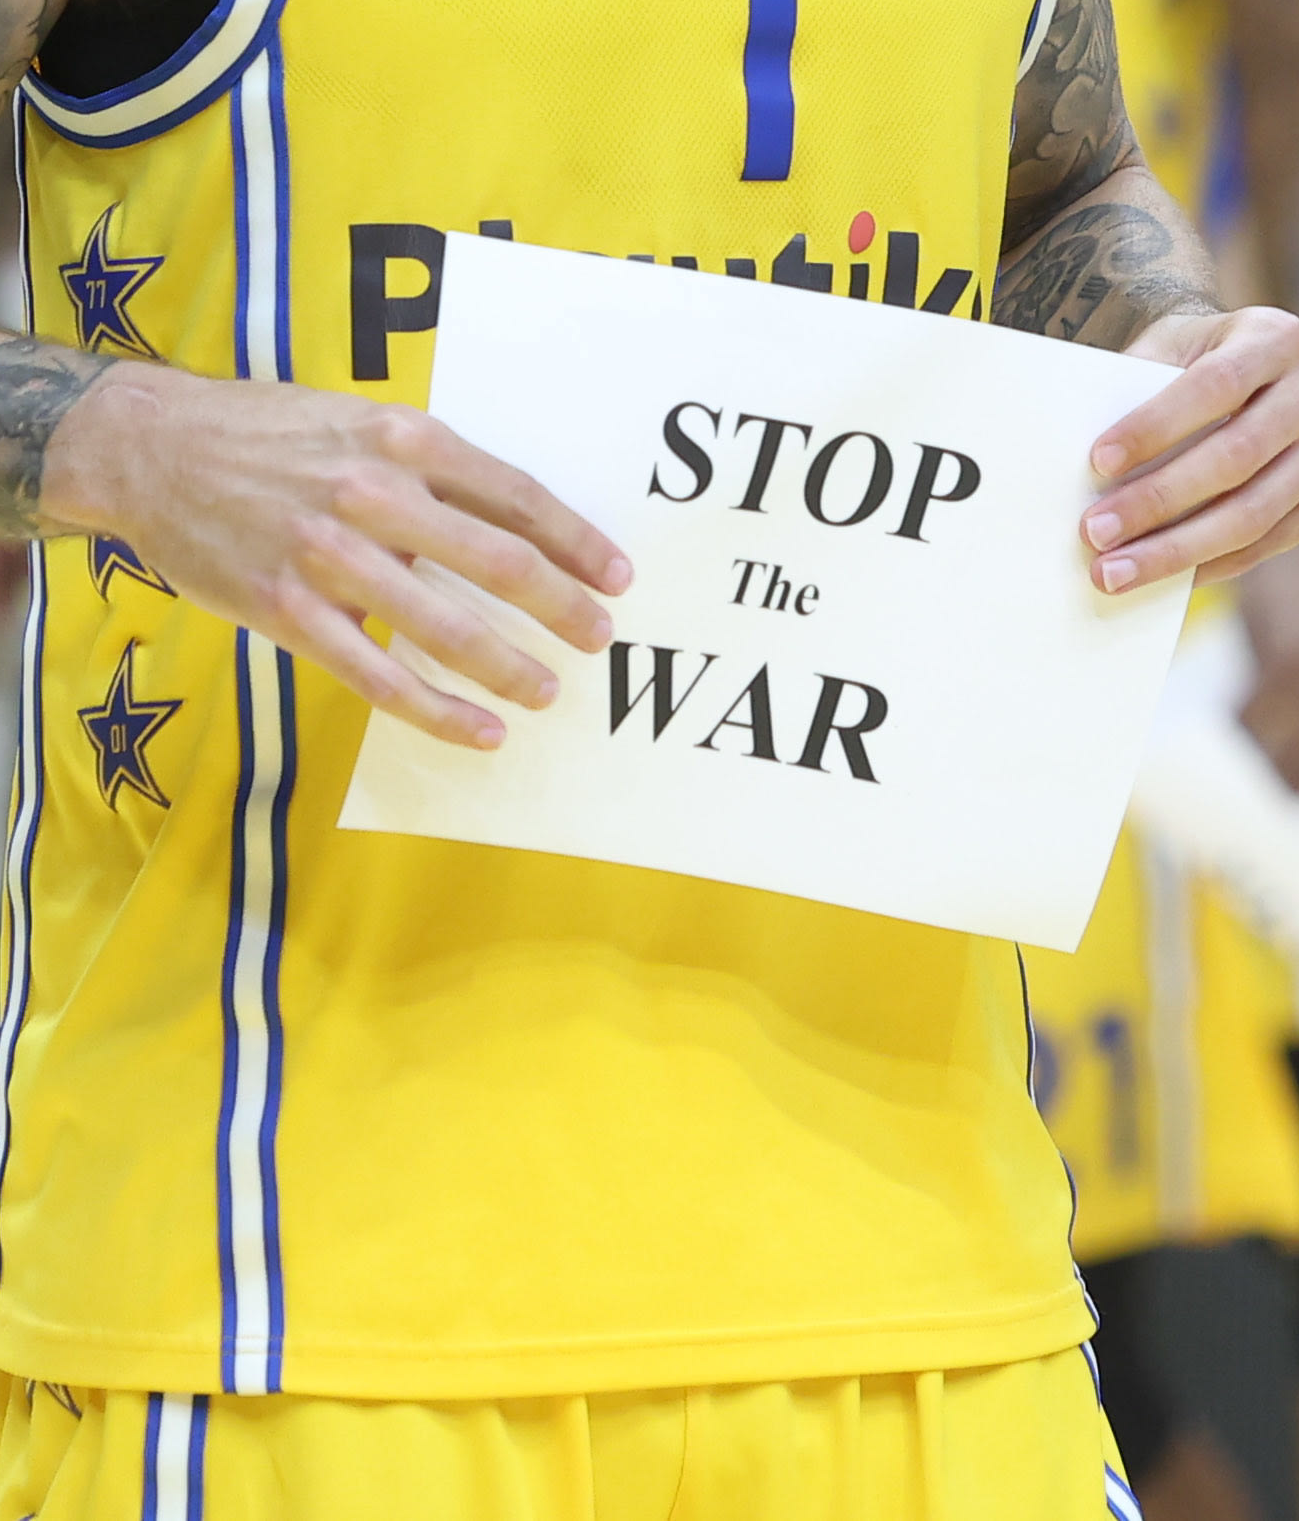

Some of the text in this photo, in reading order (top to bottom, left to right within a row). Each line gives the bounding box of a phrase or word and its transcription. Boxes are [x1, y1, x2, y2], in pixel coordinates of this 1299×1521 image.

[648, 402, 981, 542] STOP
[732, 560, 820, 616] The
[607, 640, 889, 784] WAR
